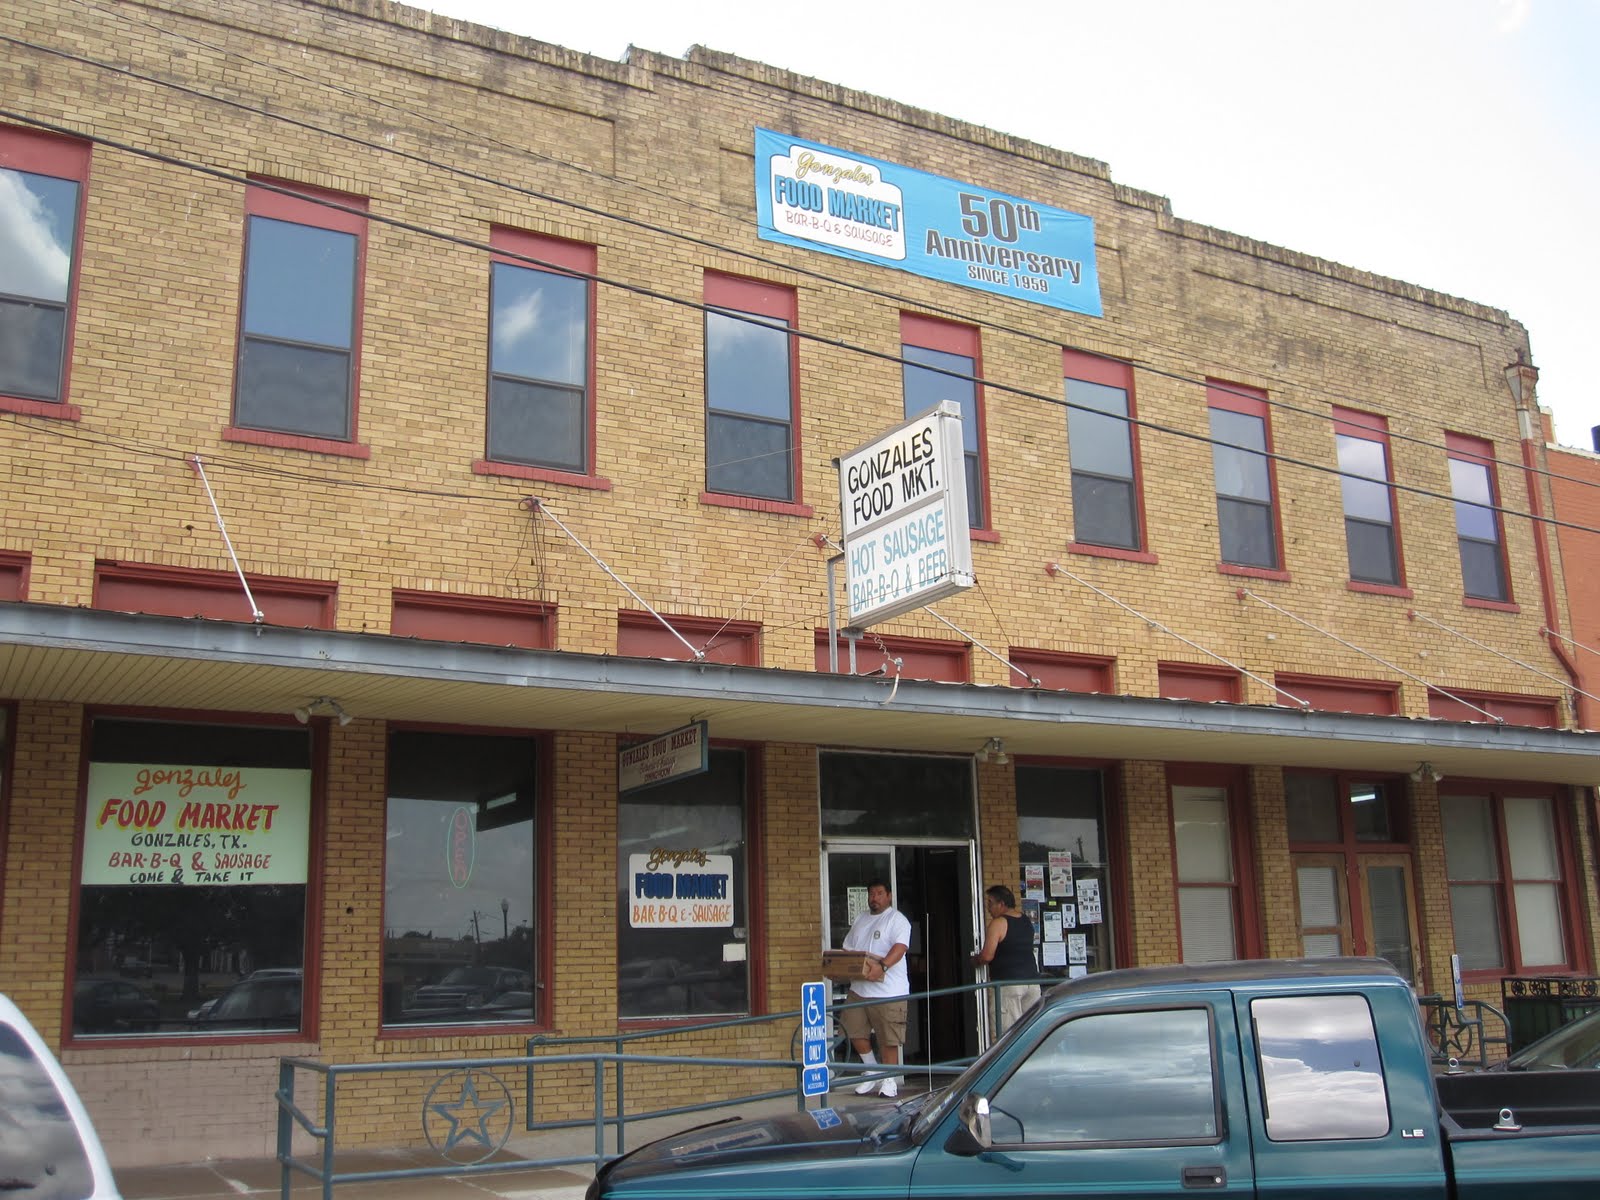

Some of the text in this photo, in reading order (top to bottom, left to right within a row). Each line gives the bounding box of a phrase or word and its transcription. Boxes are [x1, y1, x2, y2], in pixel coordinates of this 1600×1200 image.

[775, 175, 900, 232] FOOD MARKET
[785, 210, 831, 233] BAR-B-Q
[958, 192, 1041, 243] 50th
[925, 229, 1081, 285] Anniversary
[967, 265, 1049, 293] SINCE 1959
[848, 427, 933, 494] GONZALES
[853, 458, 939, 526] FOOD MKT.
[851, 508, 945, 578] HOT SAUSAGE
[852, 548, 948, 613] BAR-B-Q & BEER
[671, 728, 697, 750] MARKET
[98, 799, 279, 832] FOOD MARKET
[131, 833, 247, 849] GONZALES, TX.
[108, 852, 272, 871] BAR-B-Q & SAUSAGE
[130, 868, 254, 885] COME & TAKE IT
[635, 872, 729, 900] FOOD MARKET
[633, 905, 677, 923] BAR-B-Q
[805, 1026, 825, 1042] PARKING
[809, 1044, 821, 1061] ONLY
[811, 1073, 821, 1082] VAN
[1402, 1129, 1424, 1138] LE
